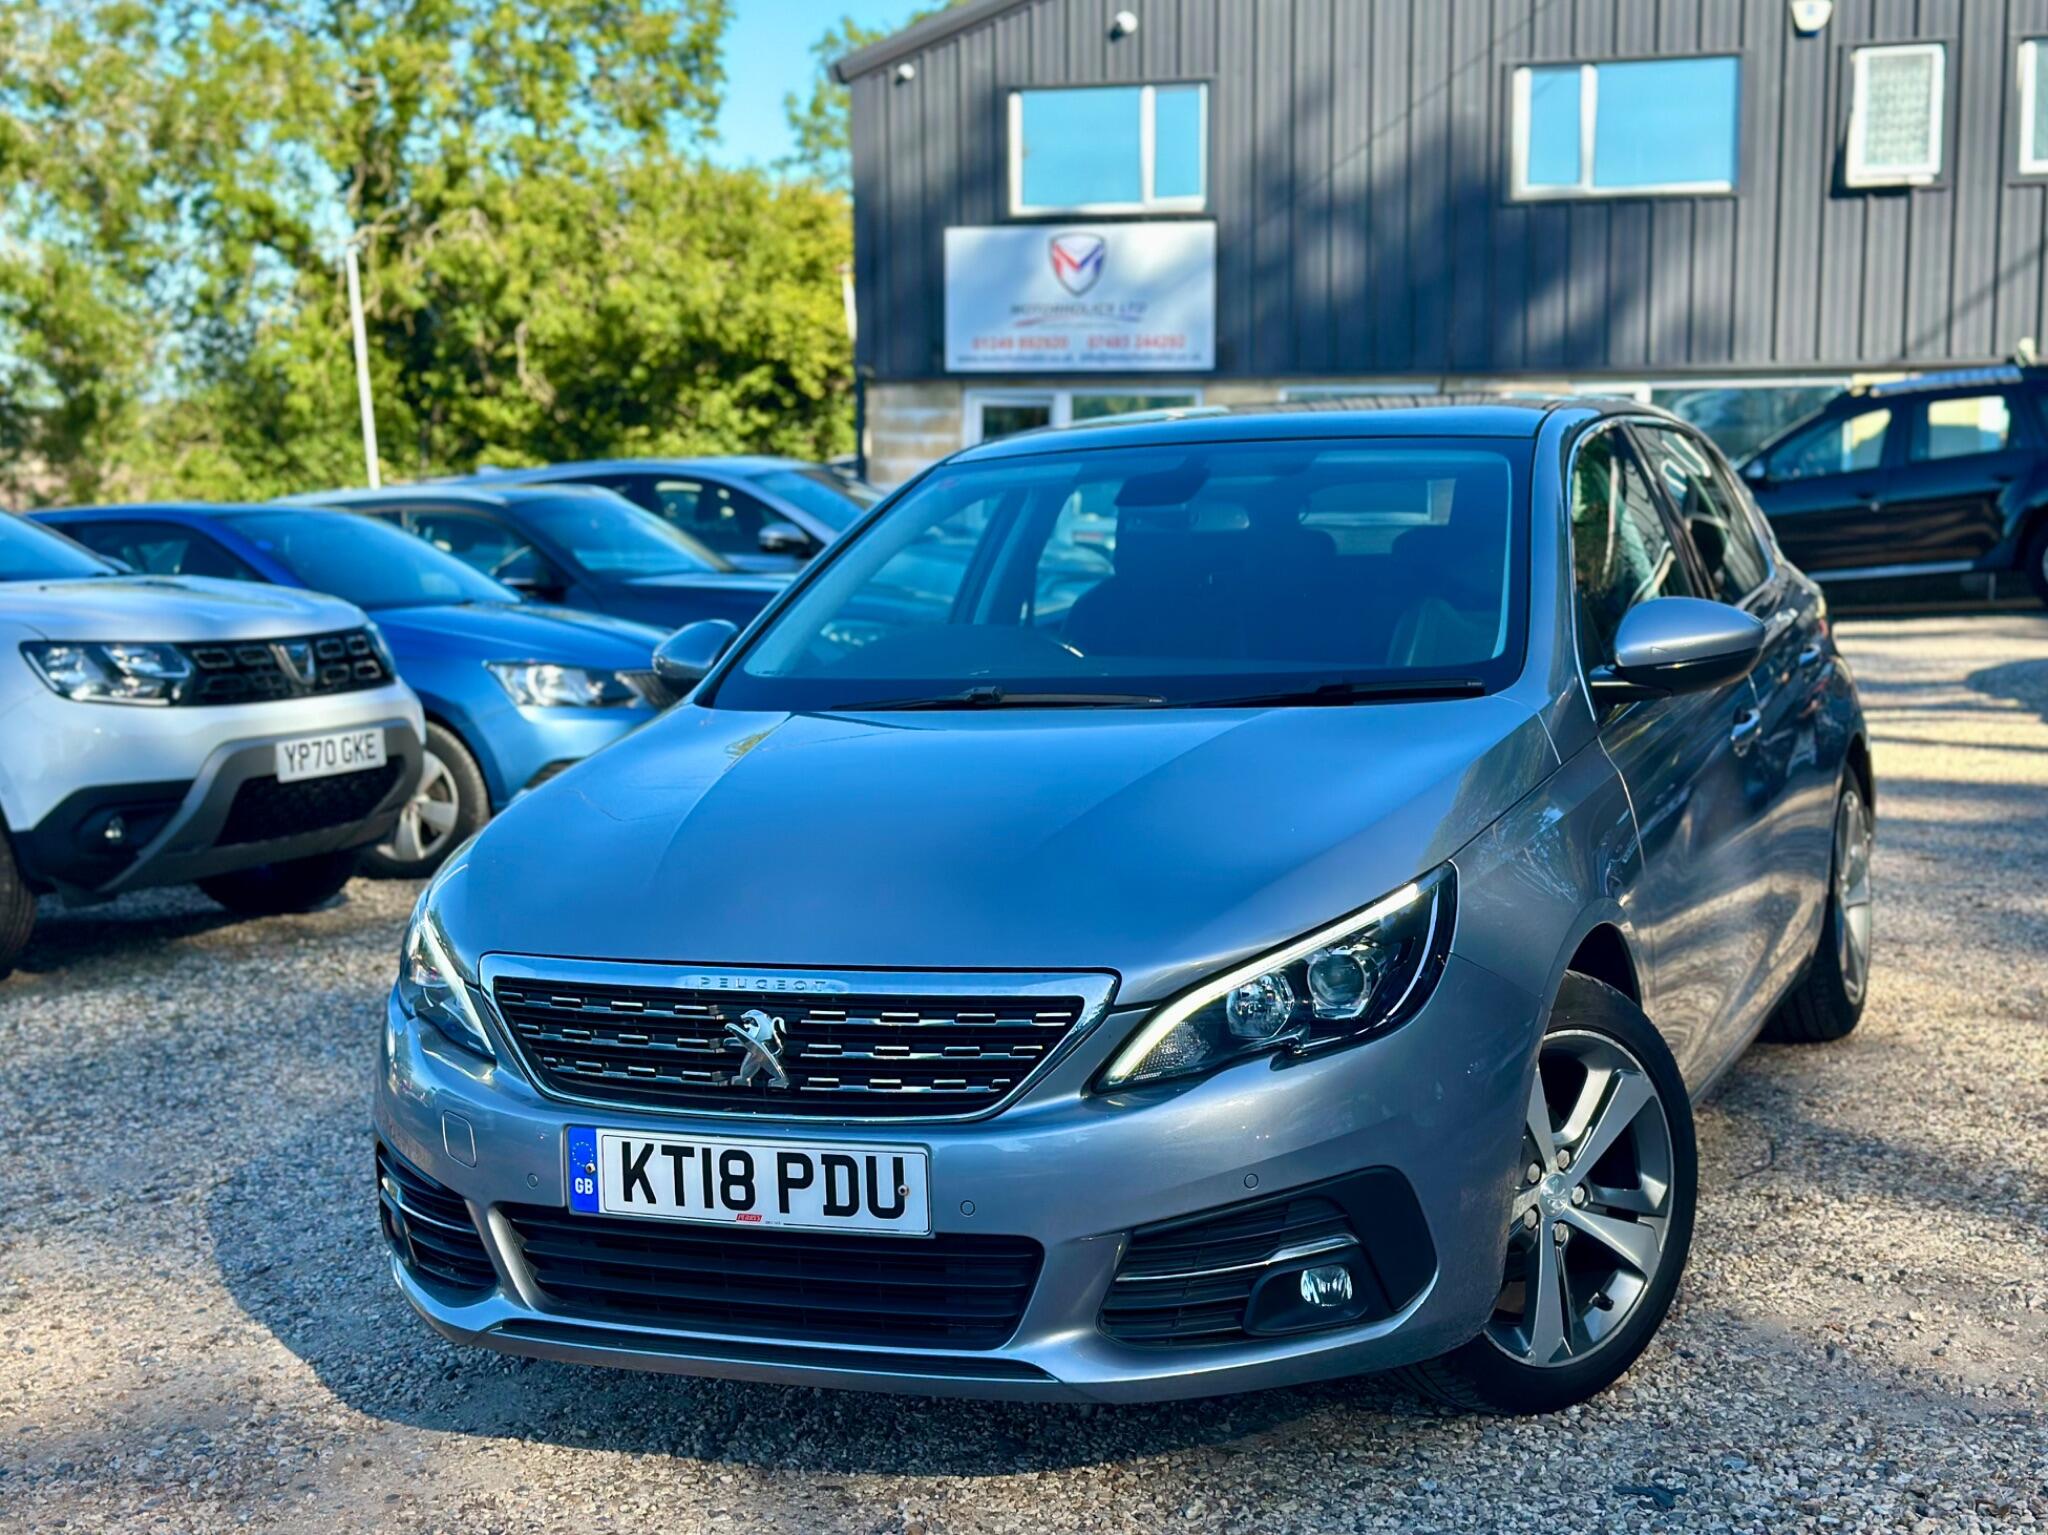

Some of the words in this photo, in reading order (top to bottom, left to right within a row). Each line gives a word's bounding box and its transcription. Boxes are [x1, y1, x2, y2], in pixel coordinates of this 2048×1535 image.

[284, 738, 337, 773] YP70
[341, 732, 377, 763] GKE
[700, 975, 827, 992] PEUGEOT
[574, 1177, 594, 1195] GB
[621, 1140, 757, 1212] KT18
[776, 1151, 907, 1220] PDU
